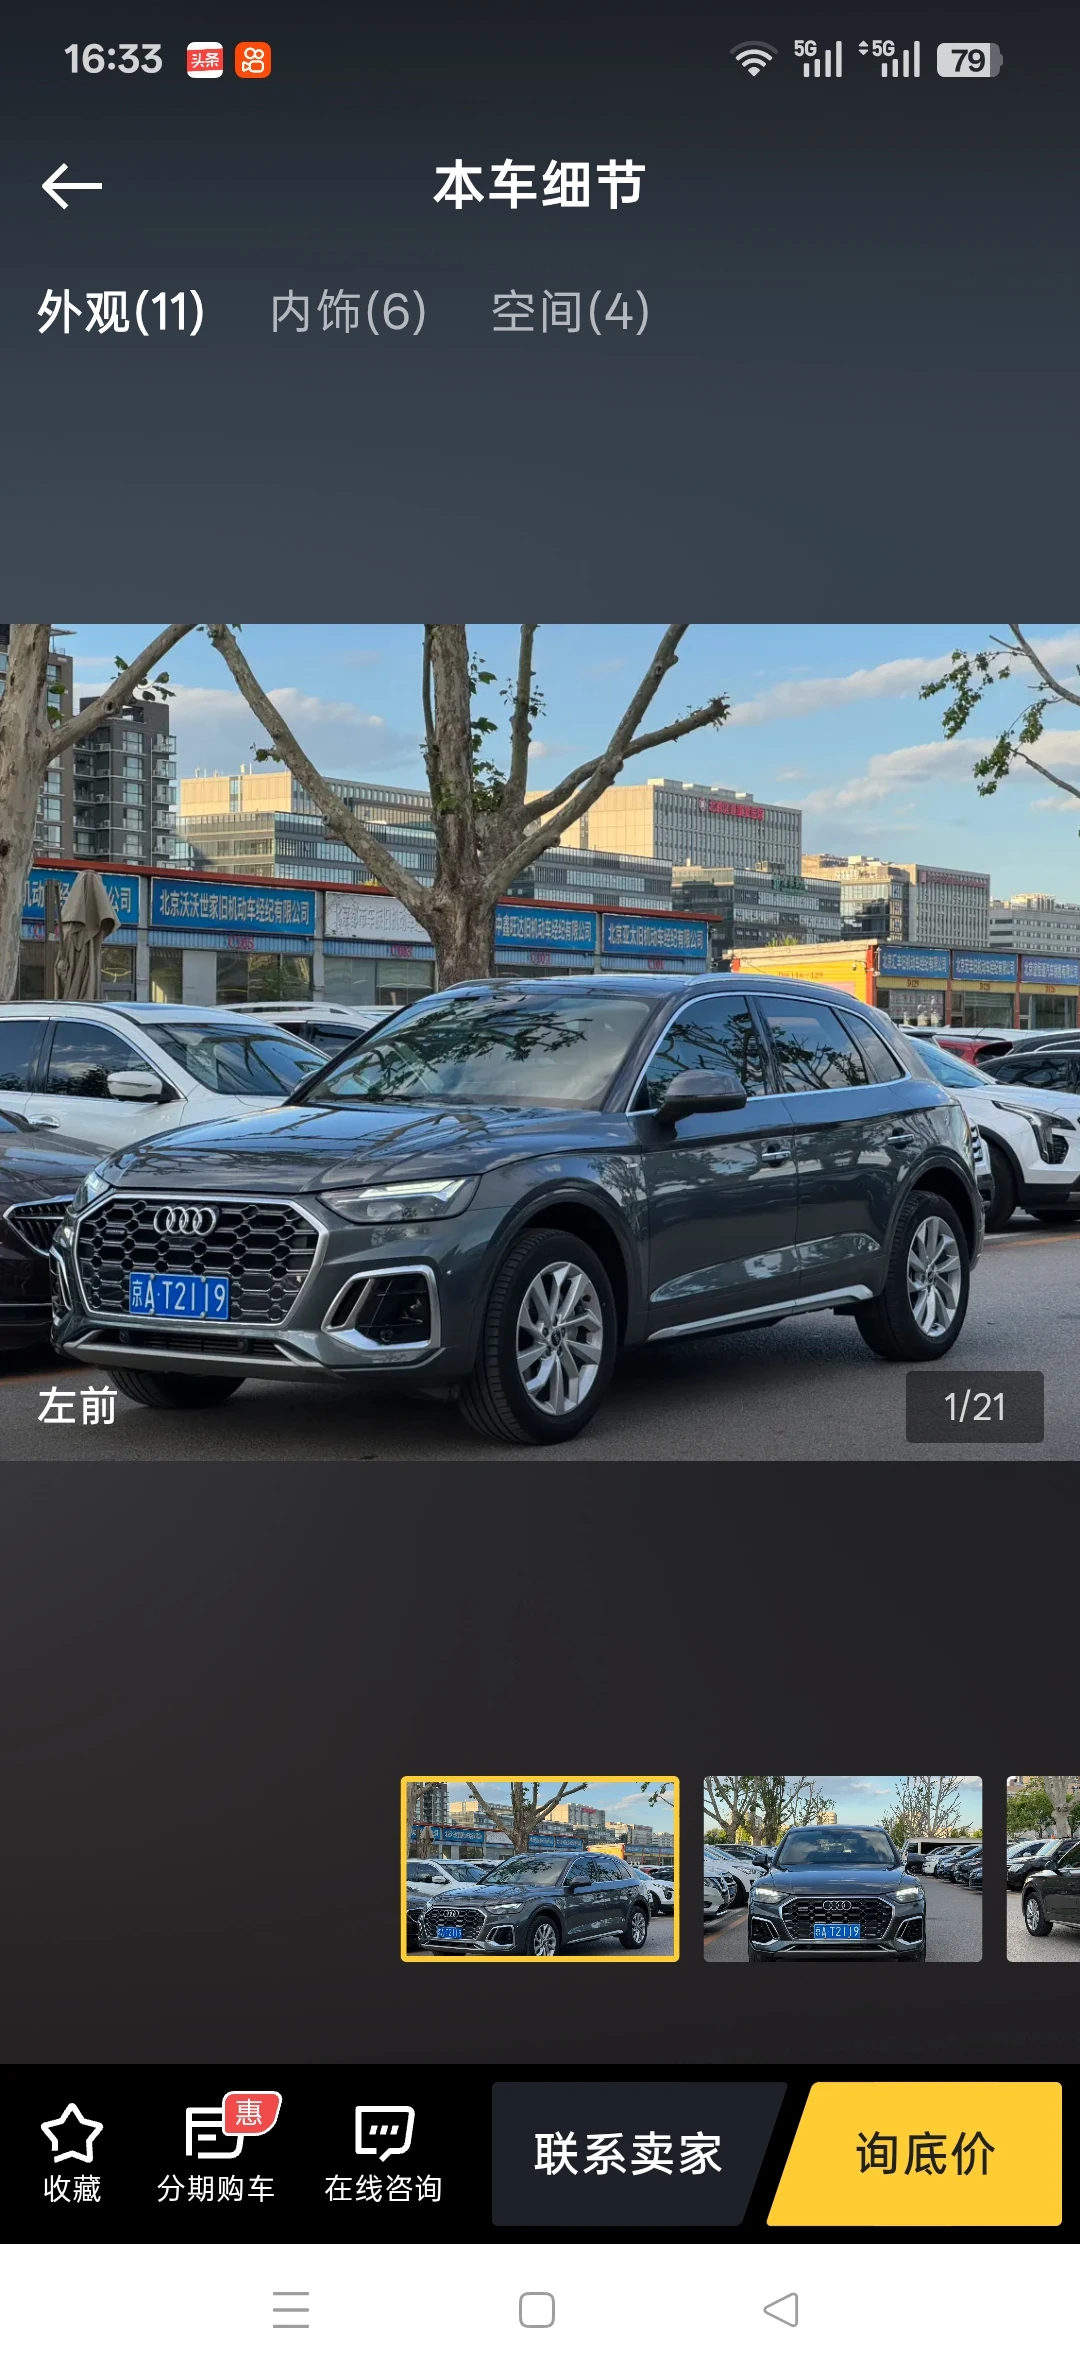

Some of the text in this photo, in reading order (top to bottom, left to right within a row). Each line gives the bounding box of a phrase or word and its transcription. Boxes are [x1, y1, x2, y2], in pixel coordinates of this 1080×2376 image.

[64, 43, 163, 74] 16:33
[191, 52, 220, 69] 头条
[794, 39, 818, 57] 5G
[872, 39, 896, 57] 5G
[951, 48, 986, 73] 79
[432, 157, 646, 210] 本车细节
[37, 288, 204, 337] 外观(11)
[272, 288, 426, 336] 内饰(6)
[492, 288, 649, 336] 空间(4)
[159, 889, 310, 925] 北京沃沃世家旧机动车经纪有限公司
[608, 923, 704, 950] 北京亚太旧机动车经纪有限公司
[235, 2098, 263, 2126] 惠
[534, 2130, 723, 2176] 联系卖家
[856, 2130, 996, 2176] 询底价
[43, 2174, 102, 2204] 收藏
[157, 2174, 275, 2203] 分期购车
[324, 2173, 442, 2203] 在线咨询
